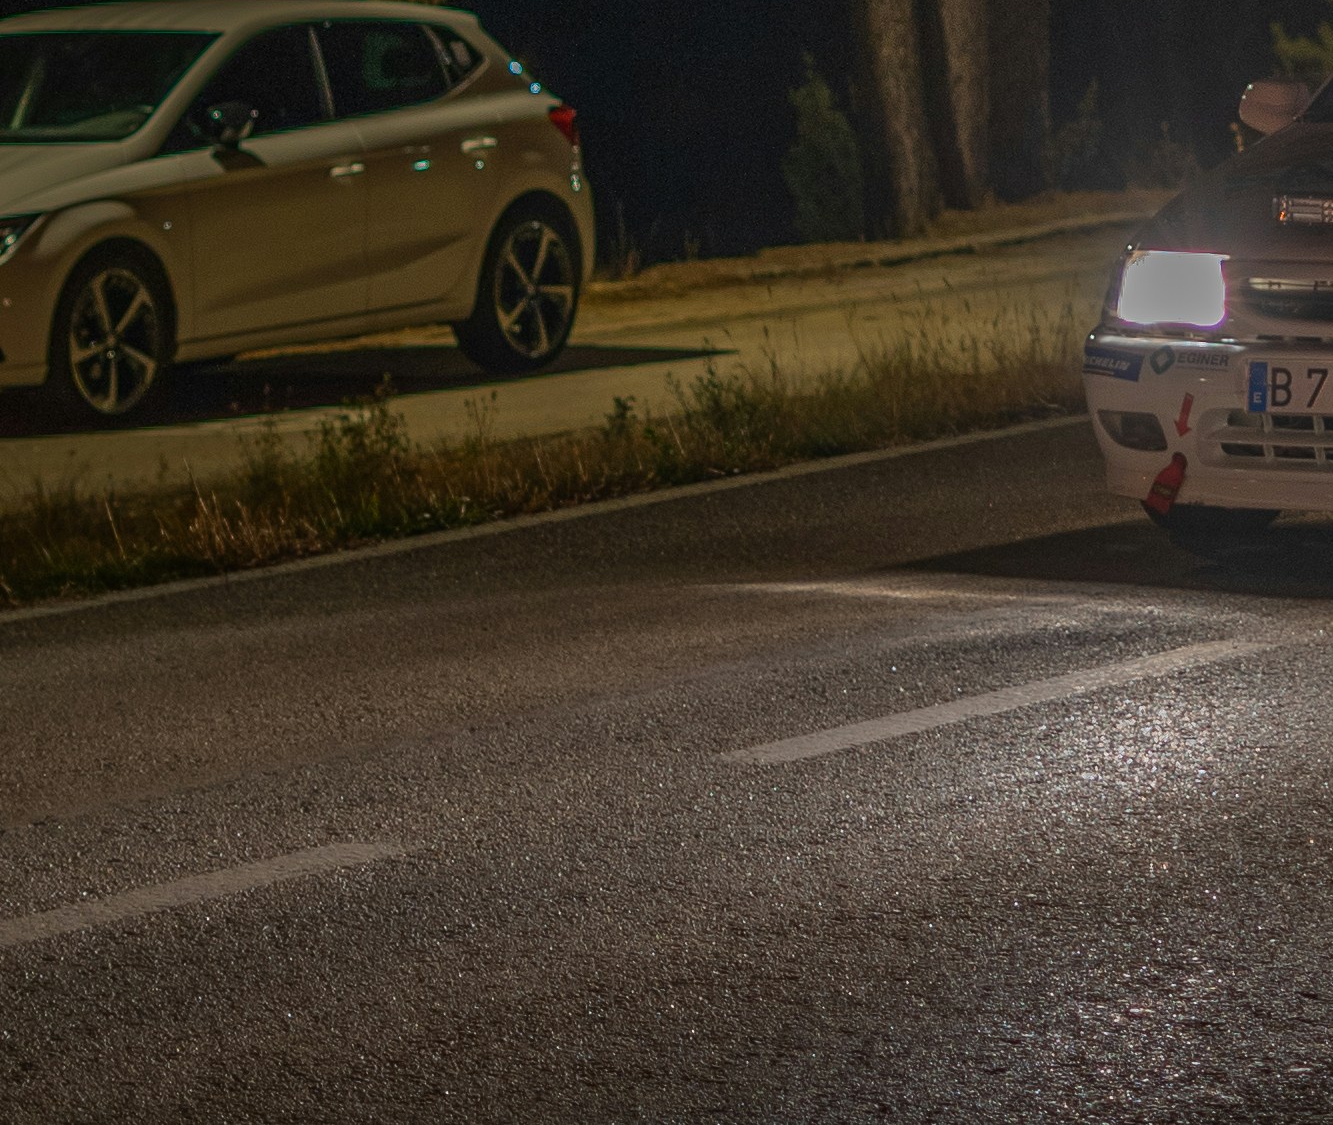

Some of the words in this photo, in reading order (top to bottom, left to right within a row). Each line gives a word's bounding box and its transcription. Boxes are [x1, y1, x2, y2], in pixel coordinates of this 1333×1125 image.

[1177, 352, 1230, 367] EGINER
[1271, 367, 1292, 407] B
[1253, 393, 1262, 404] E
